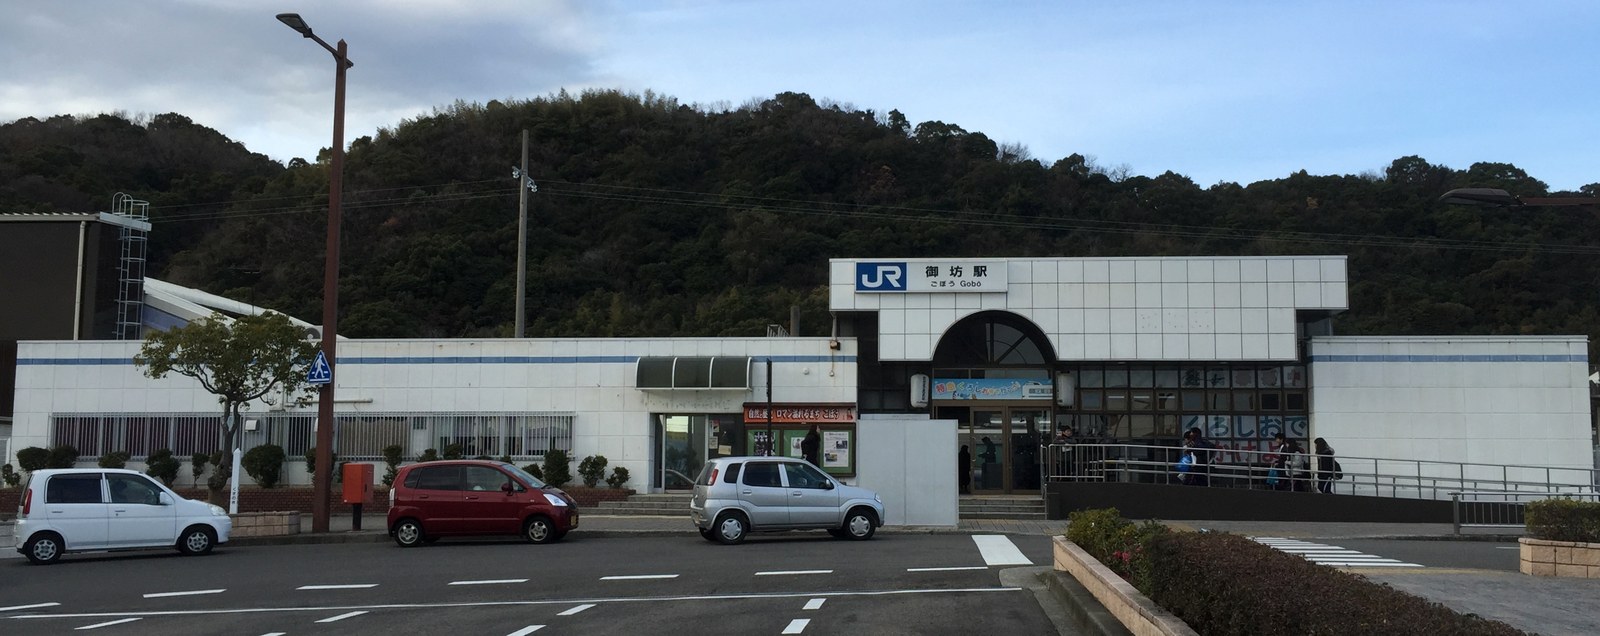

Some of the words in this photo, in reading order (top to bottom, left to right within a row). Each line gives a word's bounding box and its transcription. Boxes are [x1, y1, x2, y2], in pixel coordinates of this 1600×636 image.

[862, 266, 901, 287] JR
[925, 266, 987, 278] 御坊駅
